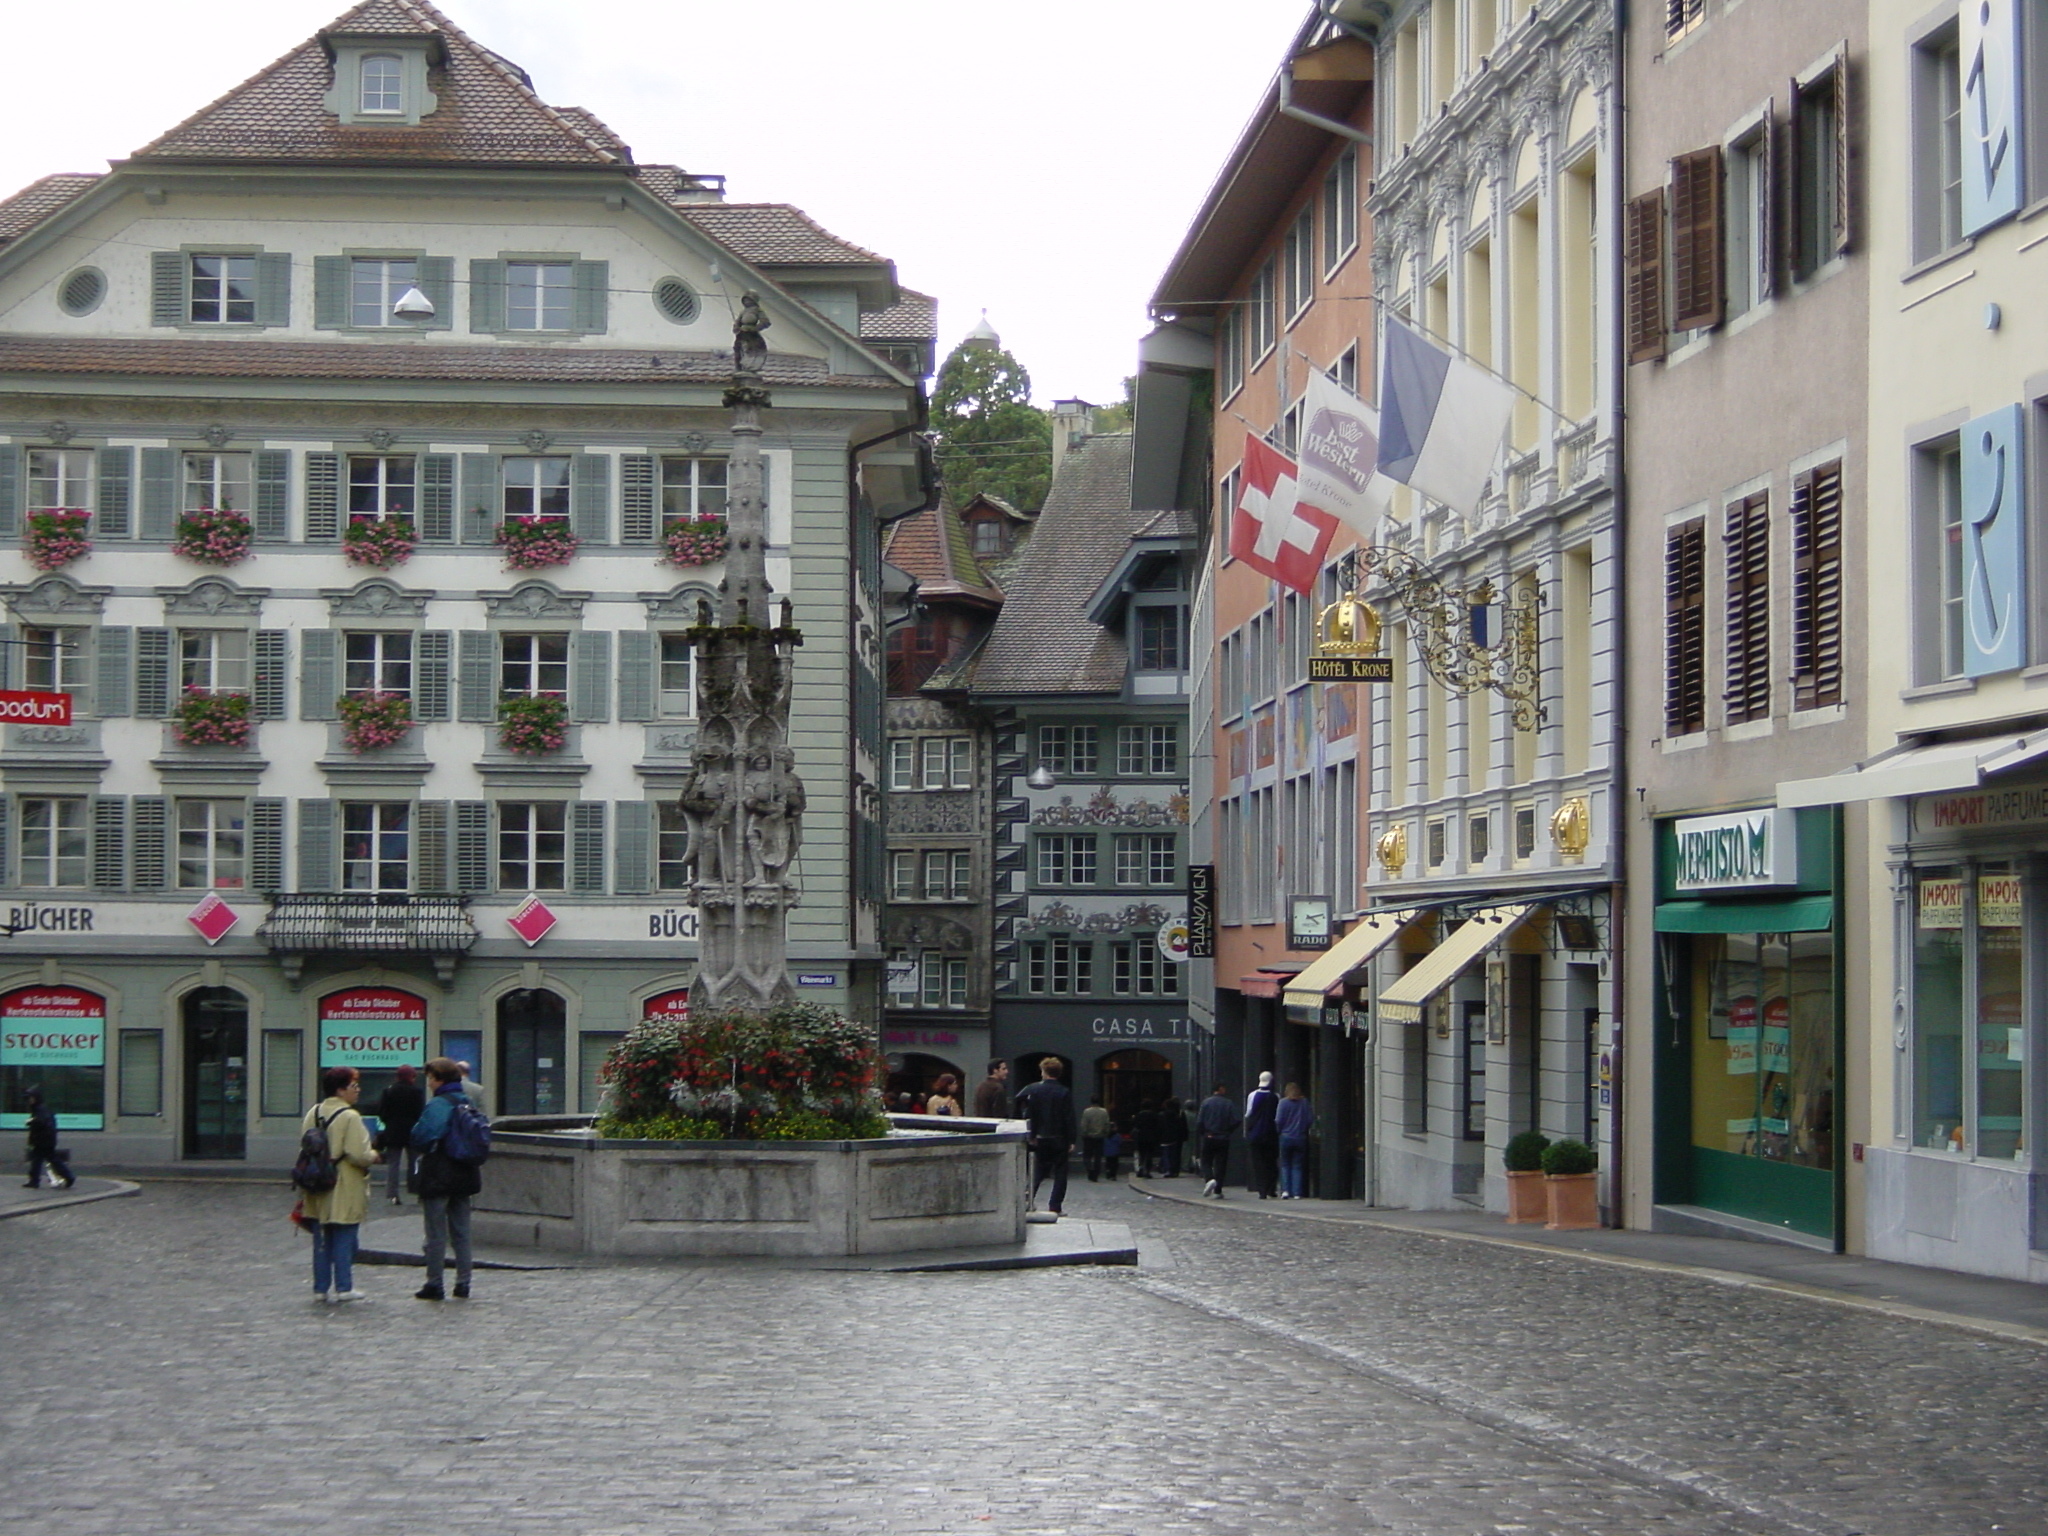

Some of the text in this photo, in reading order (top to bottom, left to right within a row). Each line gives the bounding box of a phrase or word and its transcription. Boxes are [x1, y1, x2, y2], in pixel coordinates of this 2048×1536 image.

[1308, 433, 1366, 486] Western
[1321, 484, 1352, 508] Krone
[1352, 660, 1390, 677] KRONE
[1934, 796, 1985, 827] IMPORT
[1676, 824, 1744, 881] MEPHISTO
[1922, 884, 1963, 907] IMPORT
[10, 903, 94, 931] BÜCHER
[1293, 935, 1328, 945] RADO
[353, 998, 371, 1008] Ende
[373, 998, 401, 1008] Oktober
[1092, 1018, 1153, 1035] CASA
